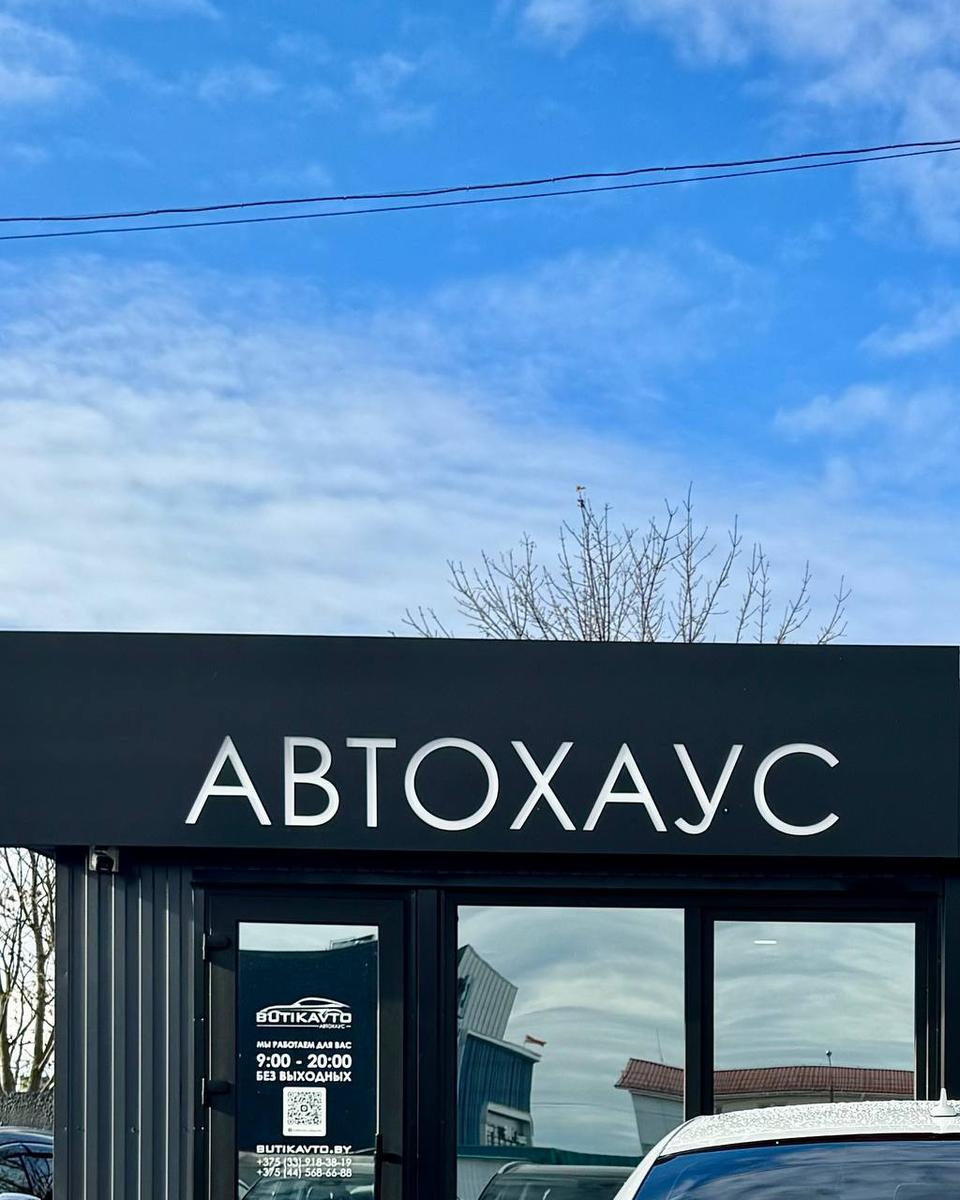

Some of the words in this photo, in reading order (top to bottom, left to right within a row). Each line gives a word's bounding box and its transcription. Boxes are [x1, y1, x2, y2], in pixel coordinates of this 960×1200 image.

[185, 735, 840, 835] АВТОХАУС
[256, 1011, 352, 1023] BUTIKAVTO
[256, 1041, 271, 1049] МЫ
[272, 1041, 315, 1050] РАБОТАЕМ
[316, 1041, 333, 1050] ДЛЯ
[334, 1041, 352, 1049] ВАС
[257, 1053, 291, 1068] 9:00
[307, 1053, 352, 1069] 20:00
[256, 1071, 276, 1081] БЕЗ
[279, 1071, 352, 1083] ВЫХОДНЫХ
[256, 1145, 352, 1154] BUTIKAVTO.BY
[257, 1158, 281, 1168] +375
[283, 1157, 302, 1169] (33)
[305, 1157, 352, 1168] 918-38-19
[257, 1168, 281, 1178] +375
[283, 1168, 302, 1179] (44)
[305, 1168, 352, 1178] 568-66-88
